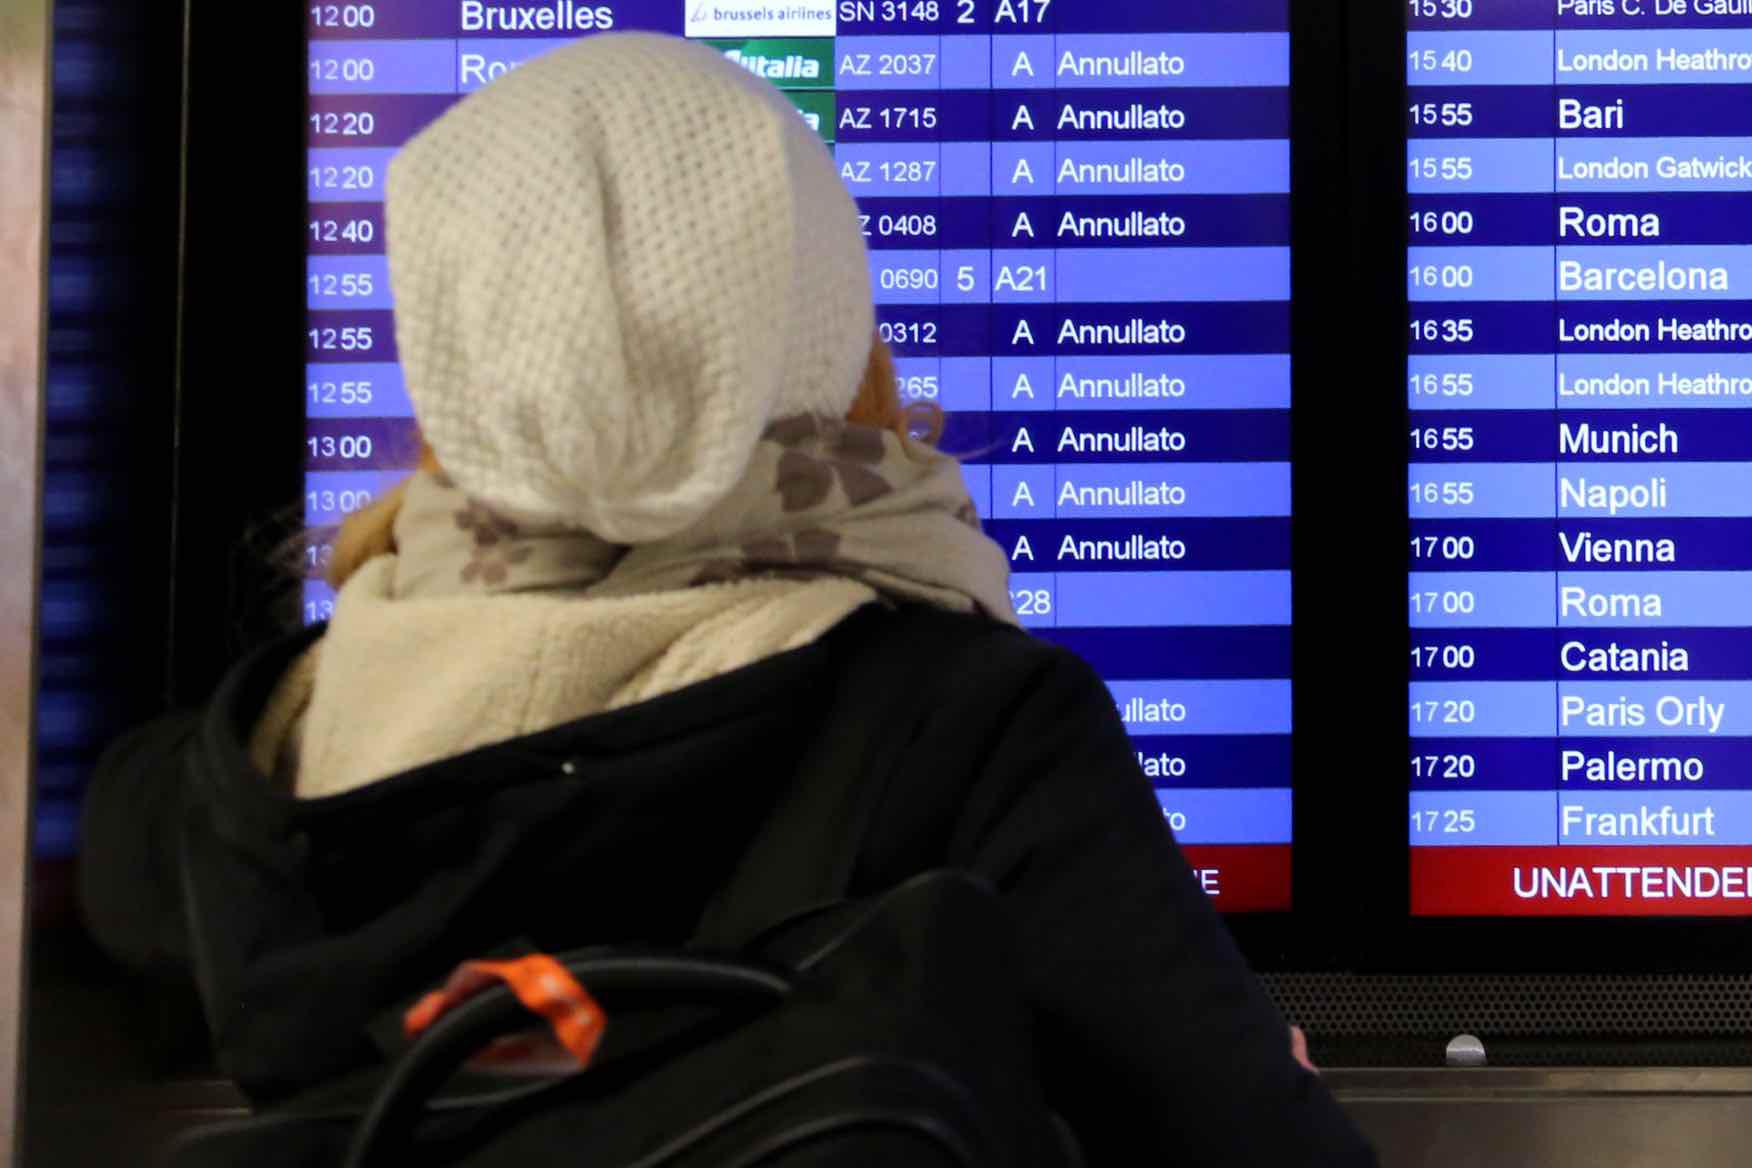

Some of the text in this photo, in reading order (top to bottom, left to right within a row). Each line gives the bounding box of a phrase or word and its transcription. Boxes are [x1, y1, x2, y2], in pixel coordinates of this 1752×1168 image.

[461, 0, 615, 32] Bruxelles
[1559, 48, 1649, 72] London
[1560, 98, 1624, 129] Bari
[840, 160, 937, 183] AZ 1287
[1561, 260, 1729, 291] Barcelona
[1057, 372, 1186, 398] Annullato
[1560, 422, 1678, 454] Munich
[1559, 531, 1676, 563] Vienna
[1561, 695, 1725, 733] Paris Orly
[1561, 750, 1704, 782] Palermo
